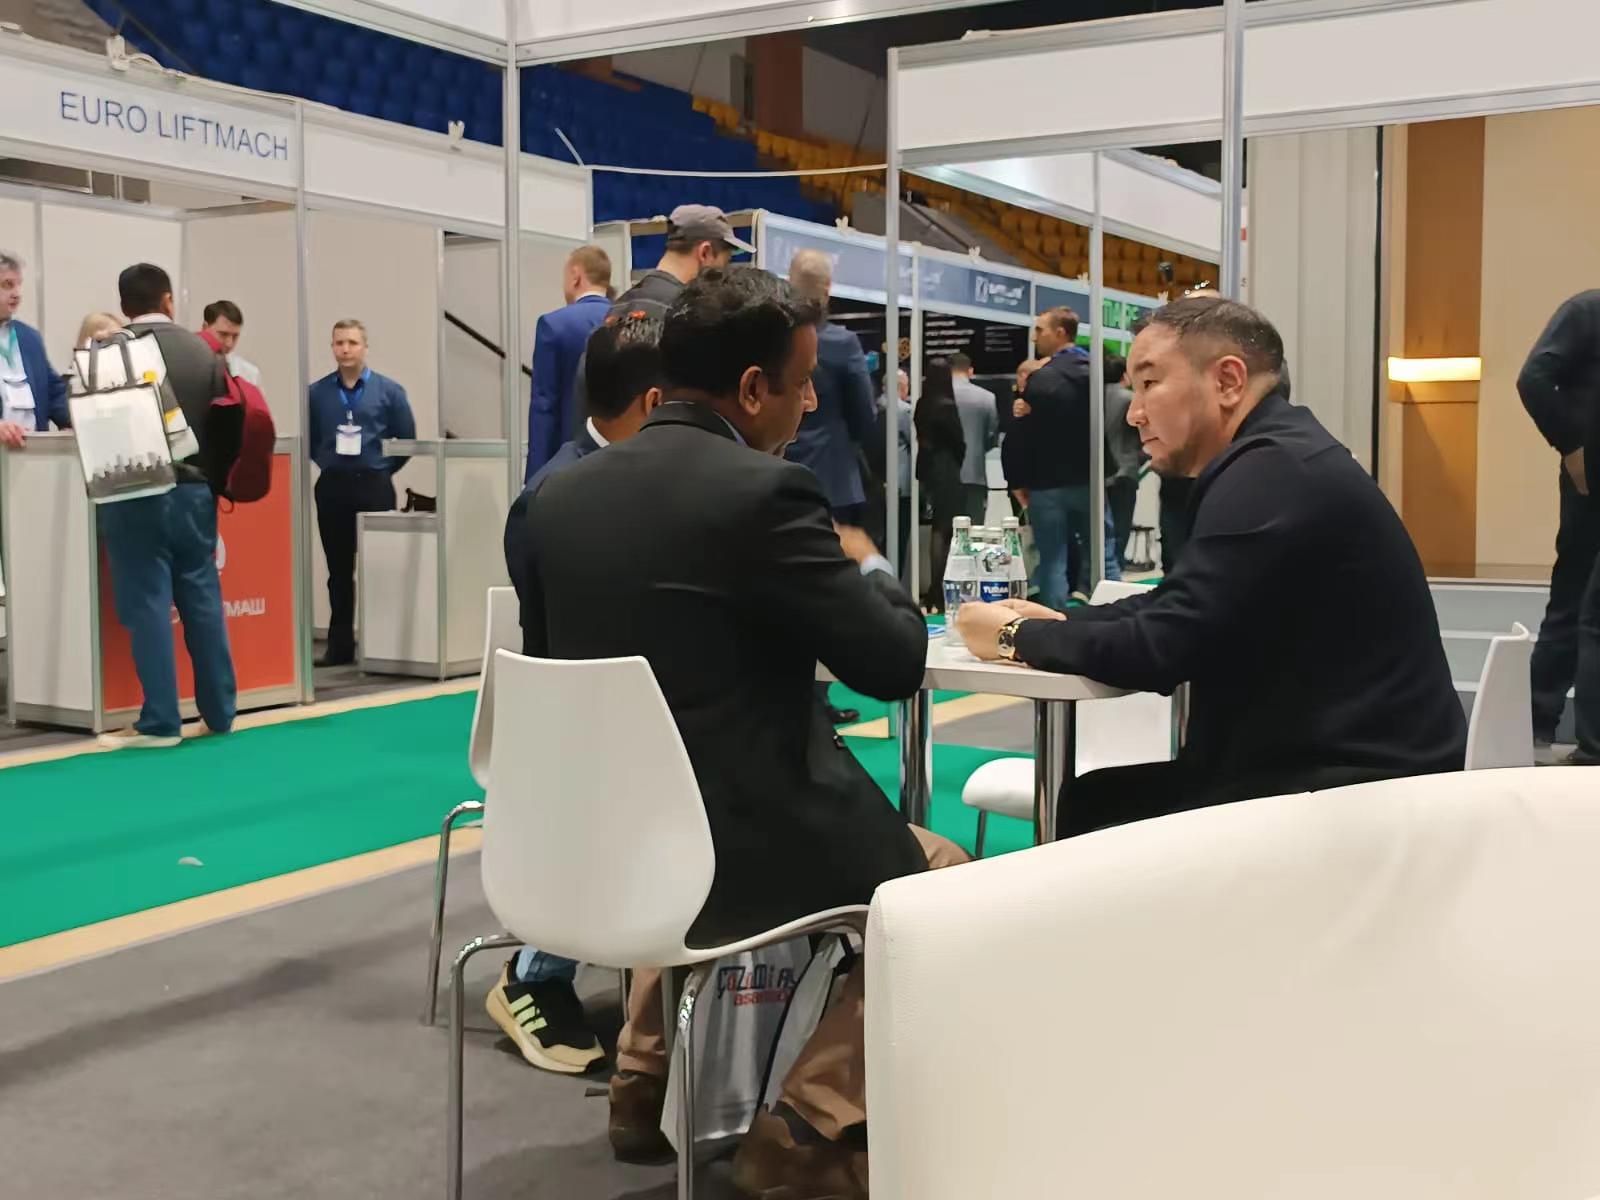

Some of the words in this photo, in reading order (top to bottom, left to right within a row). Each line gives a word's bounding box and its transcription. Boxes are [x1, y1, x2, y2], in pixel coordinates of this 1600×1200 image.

[61, 91, 147, 133] EURO
[158, 111, 288, 160] LIFTMACH
[223, 598, 266, 617] МАШ
